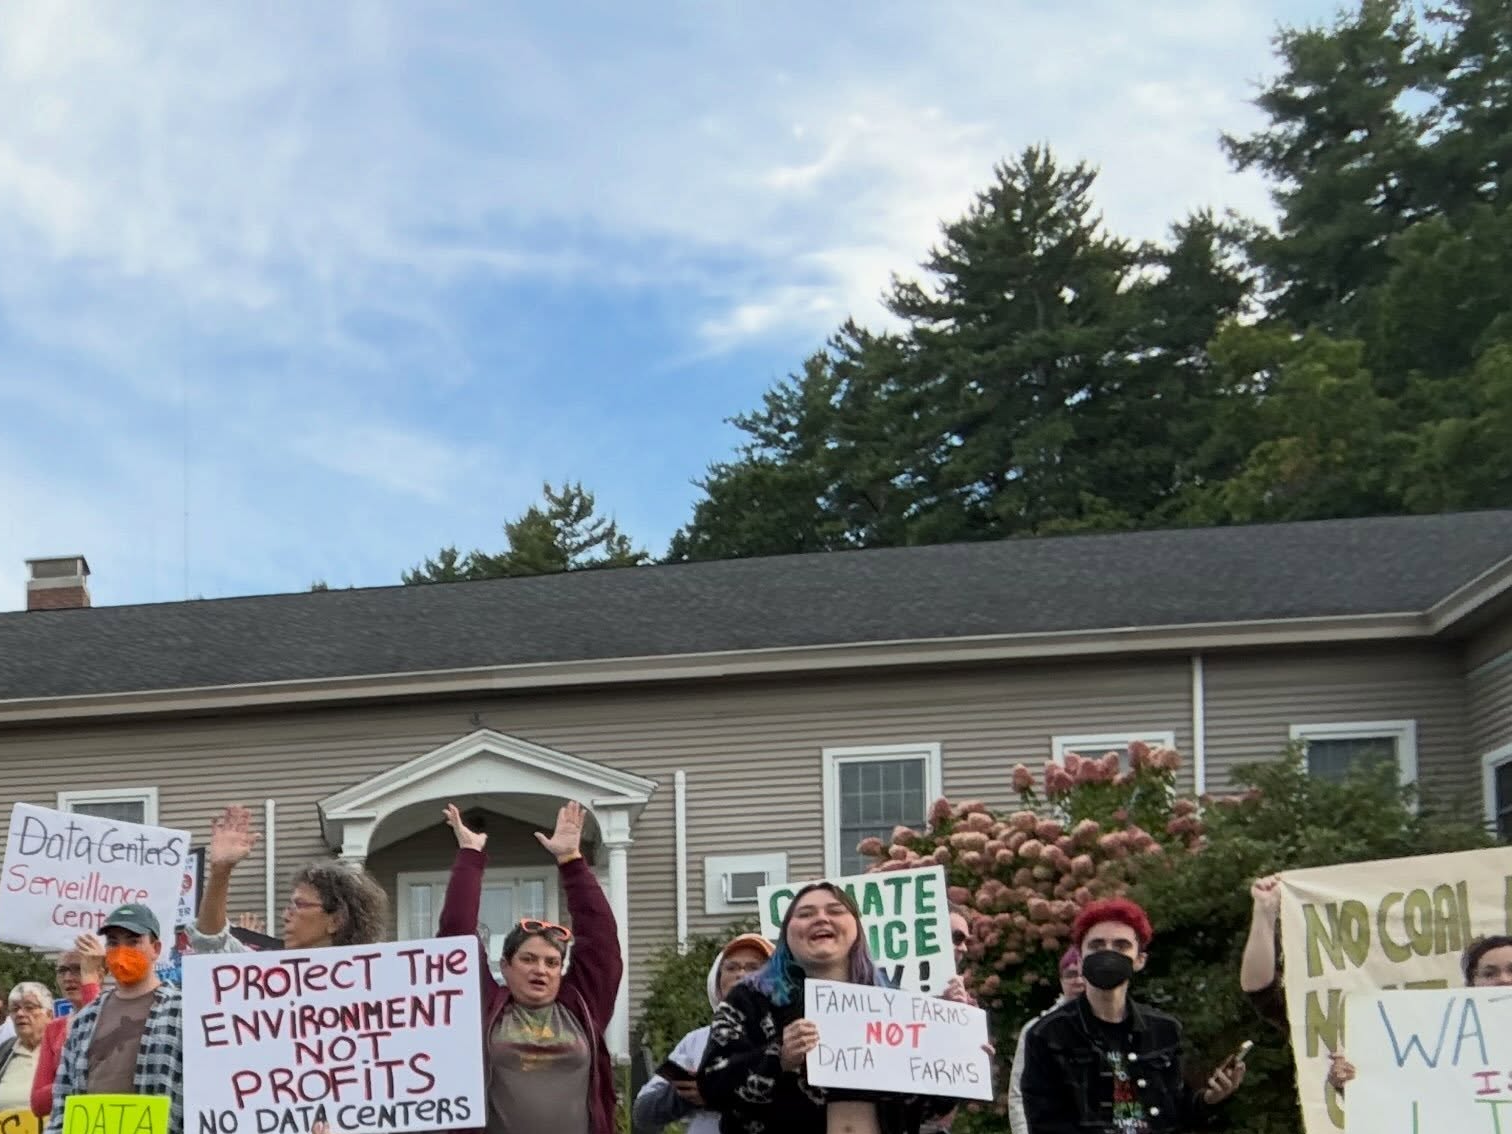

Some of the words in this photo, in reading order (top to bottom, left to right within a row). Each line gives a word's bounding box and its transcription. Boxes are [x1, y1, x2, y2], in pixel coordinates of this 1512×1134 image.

[19, 816, 91, 864] Data
[6, 864, 148, 905] Serveillance
[769, 873, 937, 928] CATE
[1302, 899, 1370, 977] NO
[1377, 880, 1475, 963] COAL
[814, 985, 896, 1017] FAMILY
[911, 998, 969, 1027] FARMS
[294, 1031, 391, 1065] NOT
[1377, 996, 1512, 1068] WA
[818, 1043, 875, 1072] DATA
[909, 1056, 979, 1085] FARMS
[1472, 1070, 1512, 1095] I
[256, 1104, 327, 1134] DATA
